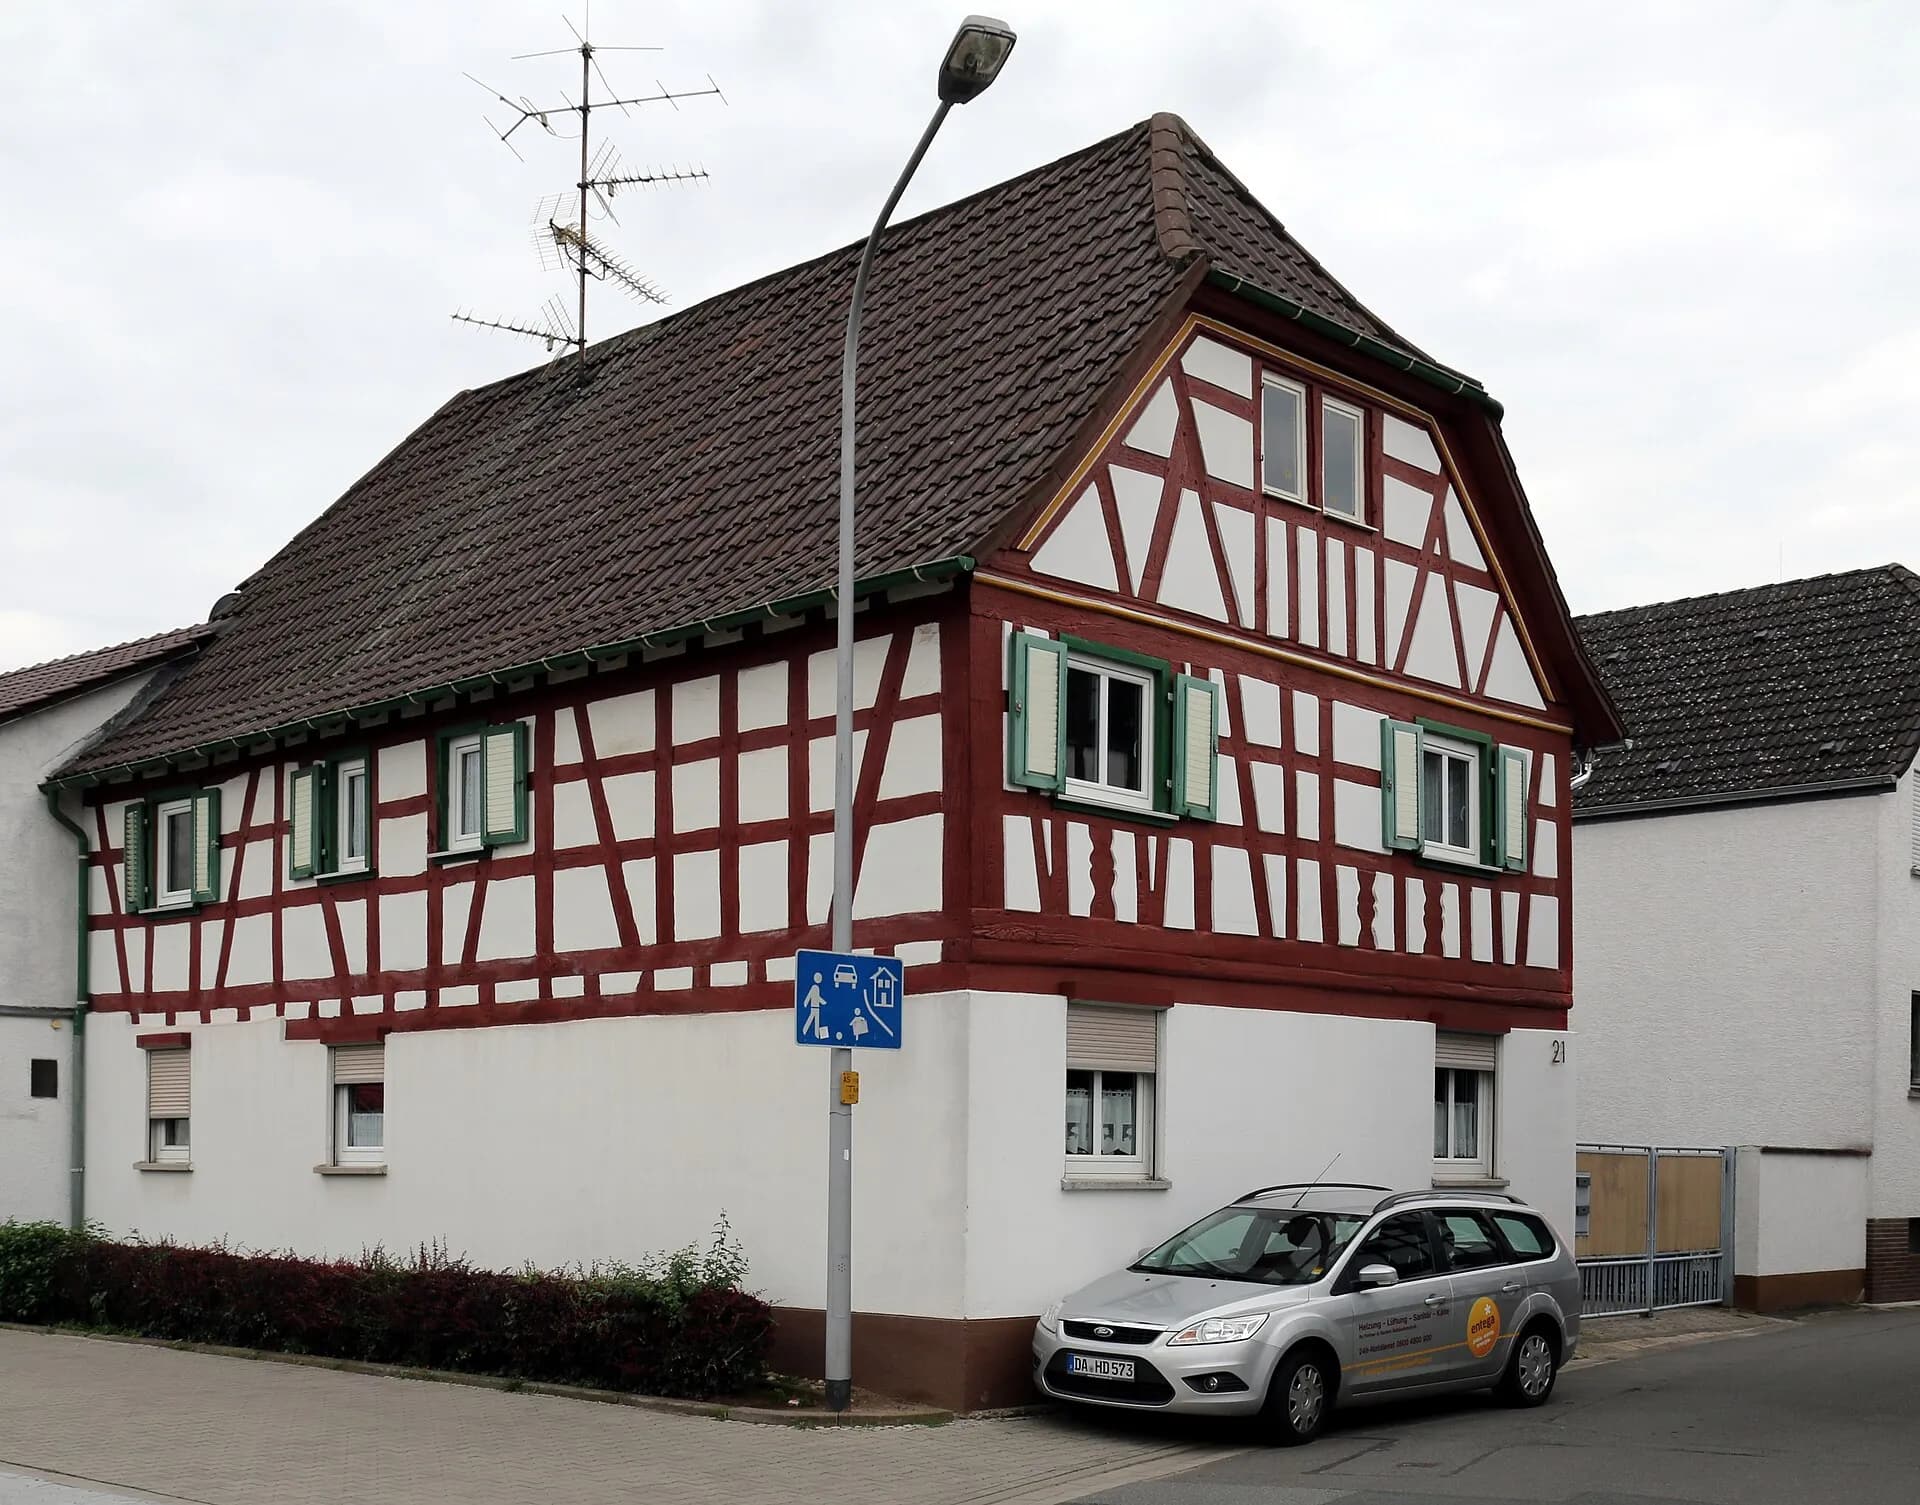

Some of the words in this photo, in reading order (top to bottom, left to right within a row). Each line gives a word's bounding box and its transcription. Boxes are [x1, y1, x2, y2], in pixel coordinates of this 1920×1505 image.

[1552, 1039, 1565, 1064] 21
[1358, 1321, 1382, 1332] Heizung
[1387, 1316, 1408, 1327] Lüftung
[1471, 1315, 1496, 1334] entega
[1074, 1357, 1088, 1372] DA
[1111, 1362, 1133, 1377] 573
